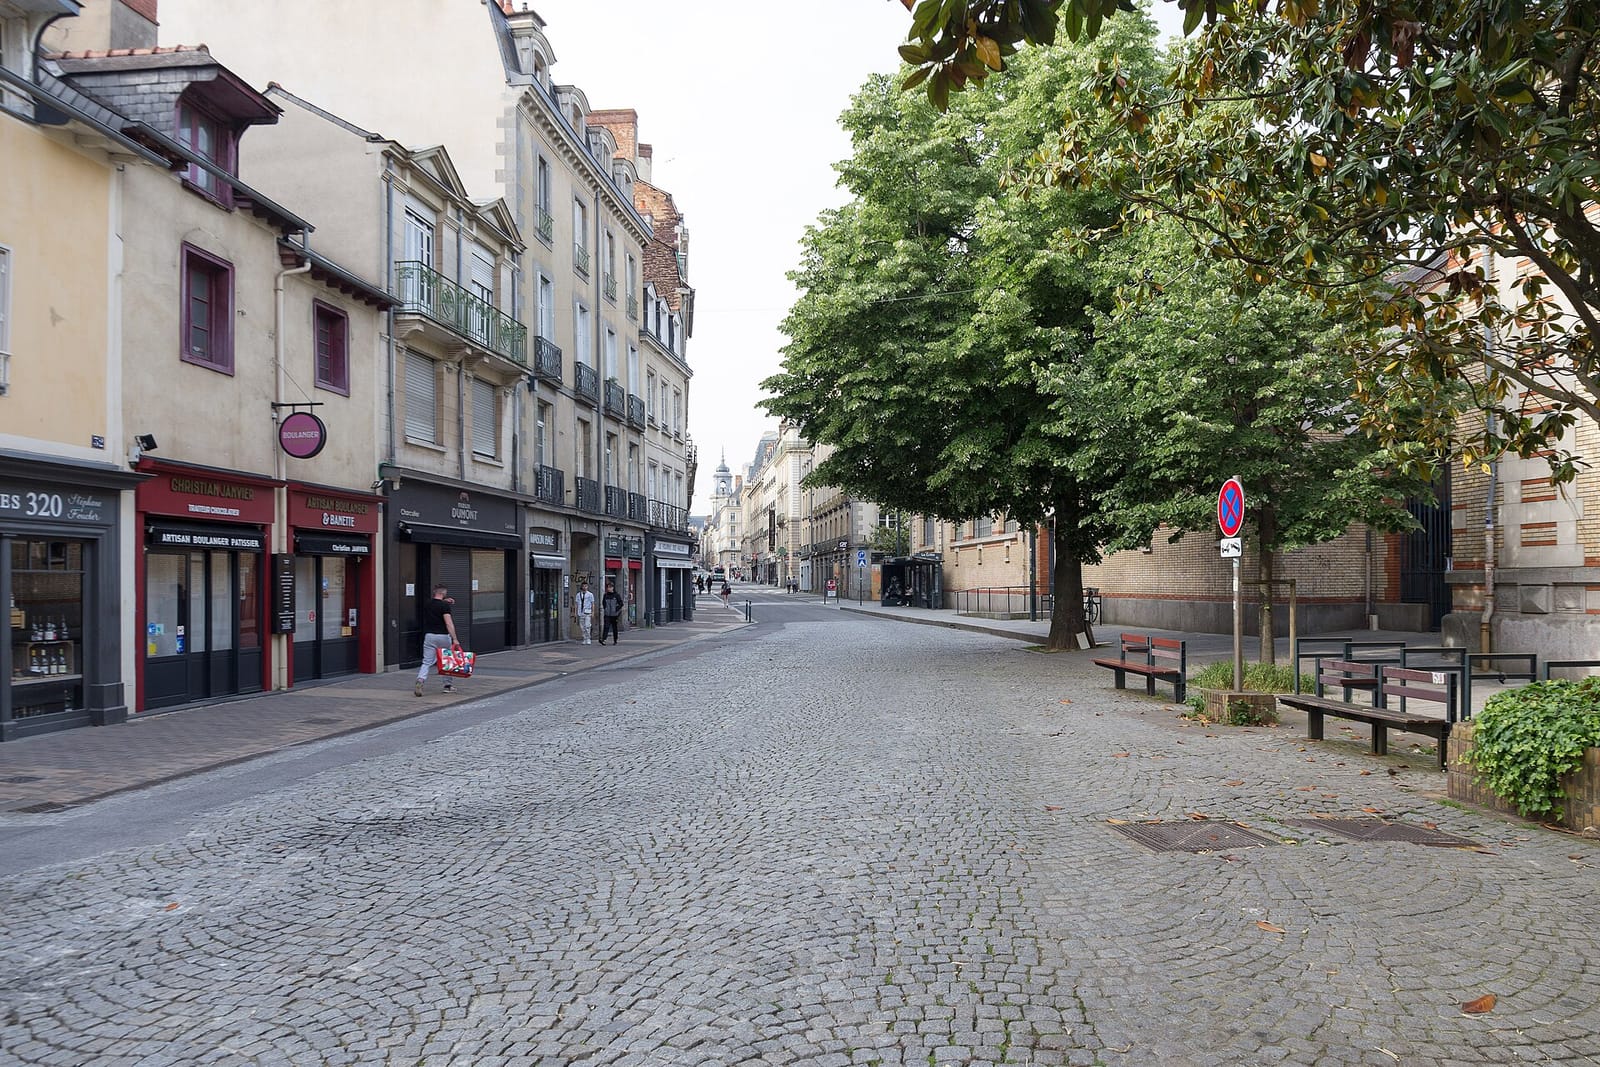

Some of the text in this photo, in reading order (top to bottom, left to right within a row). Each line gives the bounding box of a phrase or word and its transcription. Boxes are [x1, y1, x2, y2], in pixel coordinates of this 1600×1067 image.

[282, 430, 320, 439] BOULANGER
[170, 478, 255, 500] CHRISTIAN JANVIER
[25, 491, 63, 518] 320
[306, 497, 369, 515] ARTISAN BOULANGER
[322, 512, 355, 527] & BANETTE
[451, 507, 478, 520] DUMONT
[162, 533, 260, 547] ARTISAN BOULANGER PATISSIER
